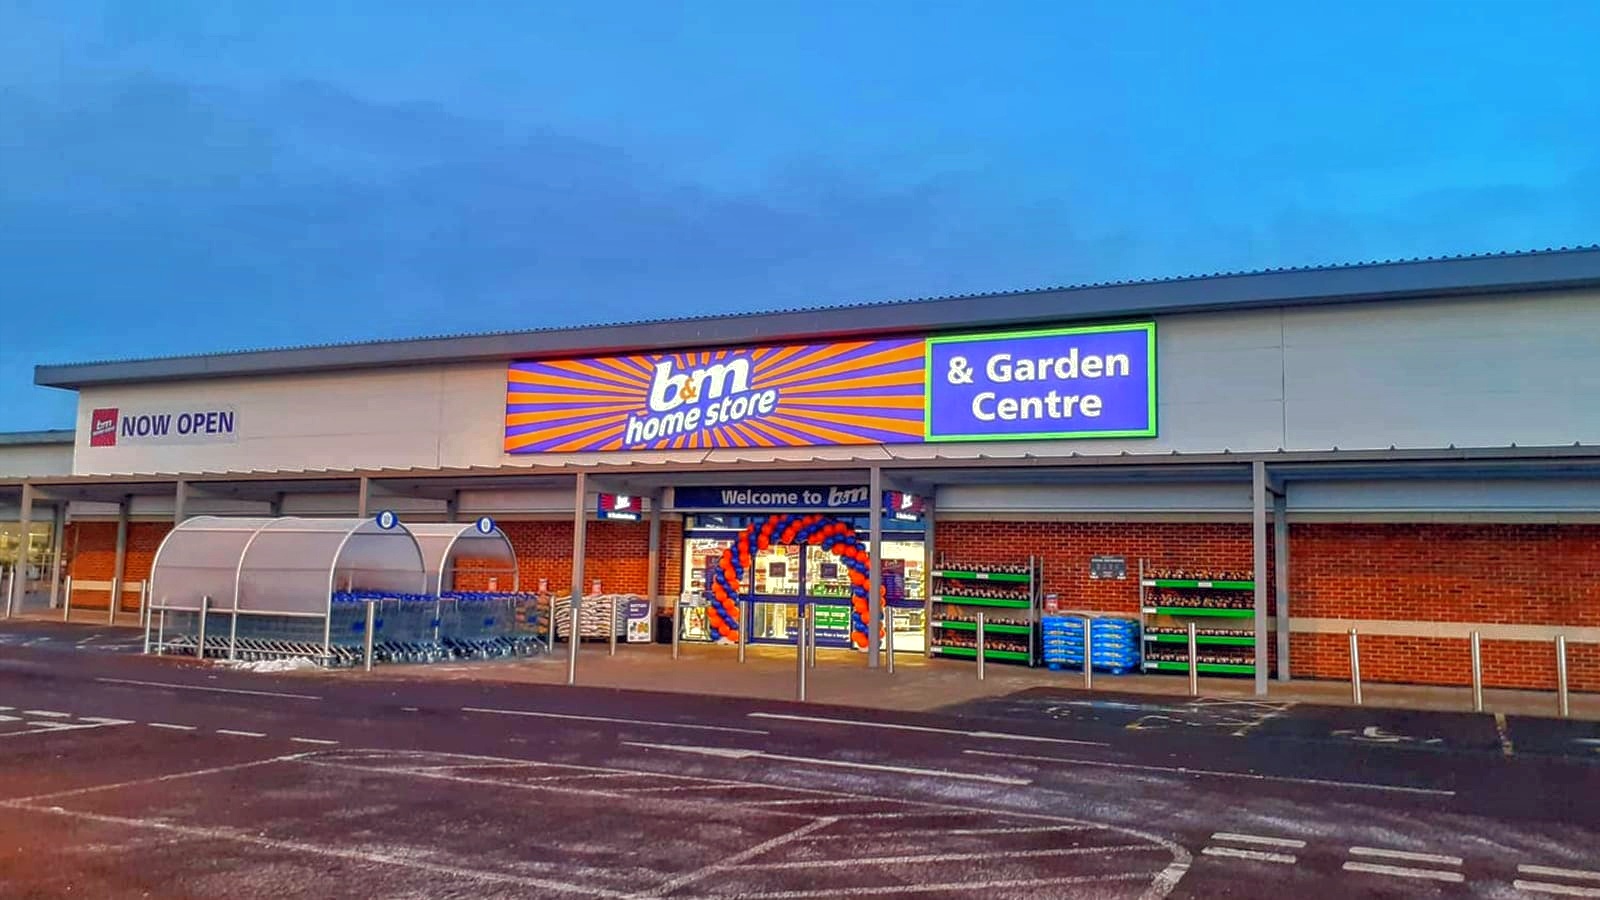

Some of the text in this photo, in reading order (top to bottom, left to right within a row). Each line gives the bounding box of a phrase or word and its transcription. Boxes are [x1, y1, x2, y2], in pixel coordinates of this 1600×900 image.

[947, 348, 1130, 385] & Garden
[650, 358, 750, 412] b&m
[625, 390, 776, 445] home store
[972, 390, 1103, 421] Centre
[122, 414, 172, 437] NOW
[177, 411, 234, 434] OPEN
[721, 489, 798, 505] Welcome
[802, 490, 822, 505] to
